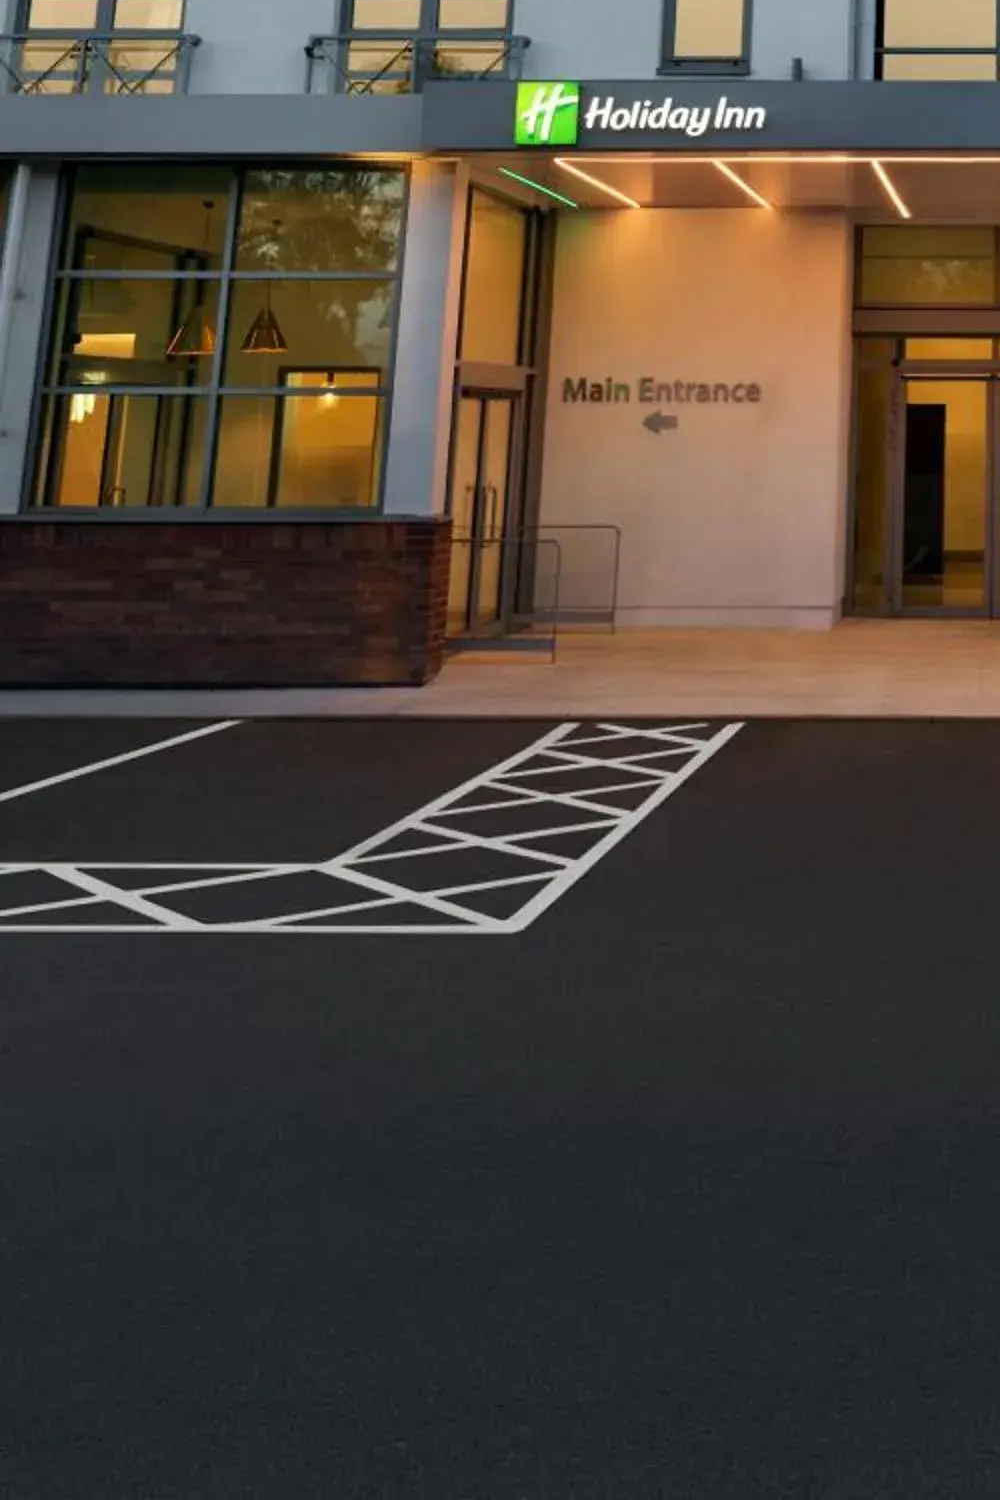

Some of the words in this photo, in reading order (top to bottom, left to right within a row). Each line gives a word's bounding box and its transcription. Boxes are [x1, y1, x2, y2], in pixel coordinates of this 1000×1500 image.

[584, 96, 711, 137] Holiday
[714, 96, 766, 130] Inn
[562, 376, 631, 403] Main
[638, 376, 762, 403] Entrance
